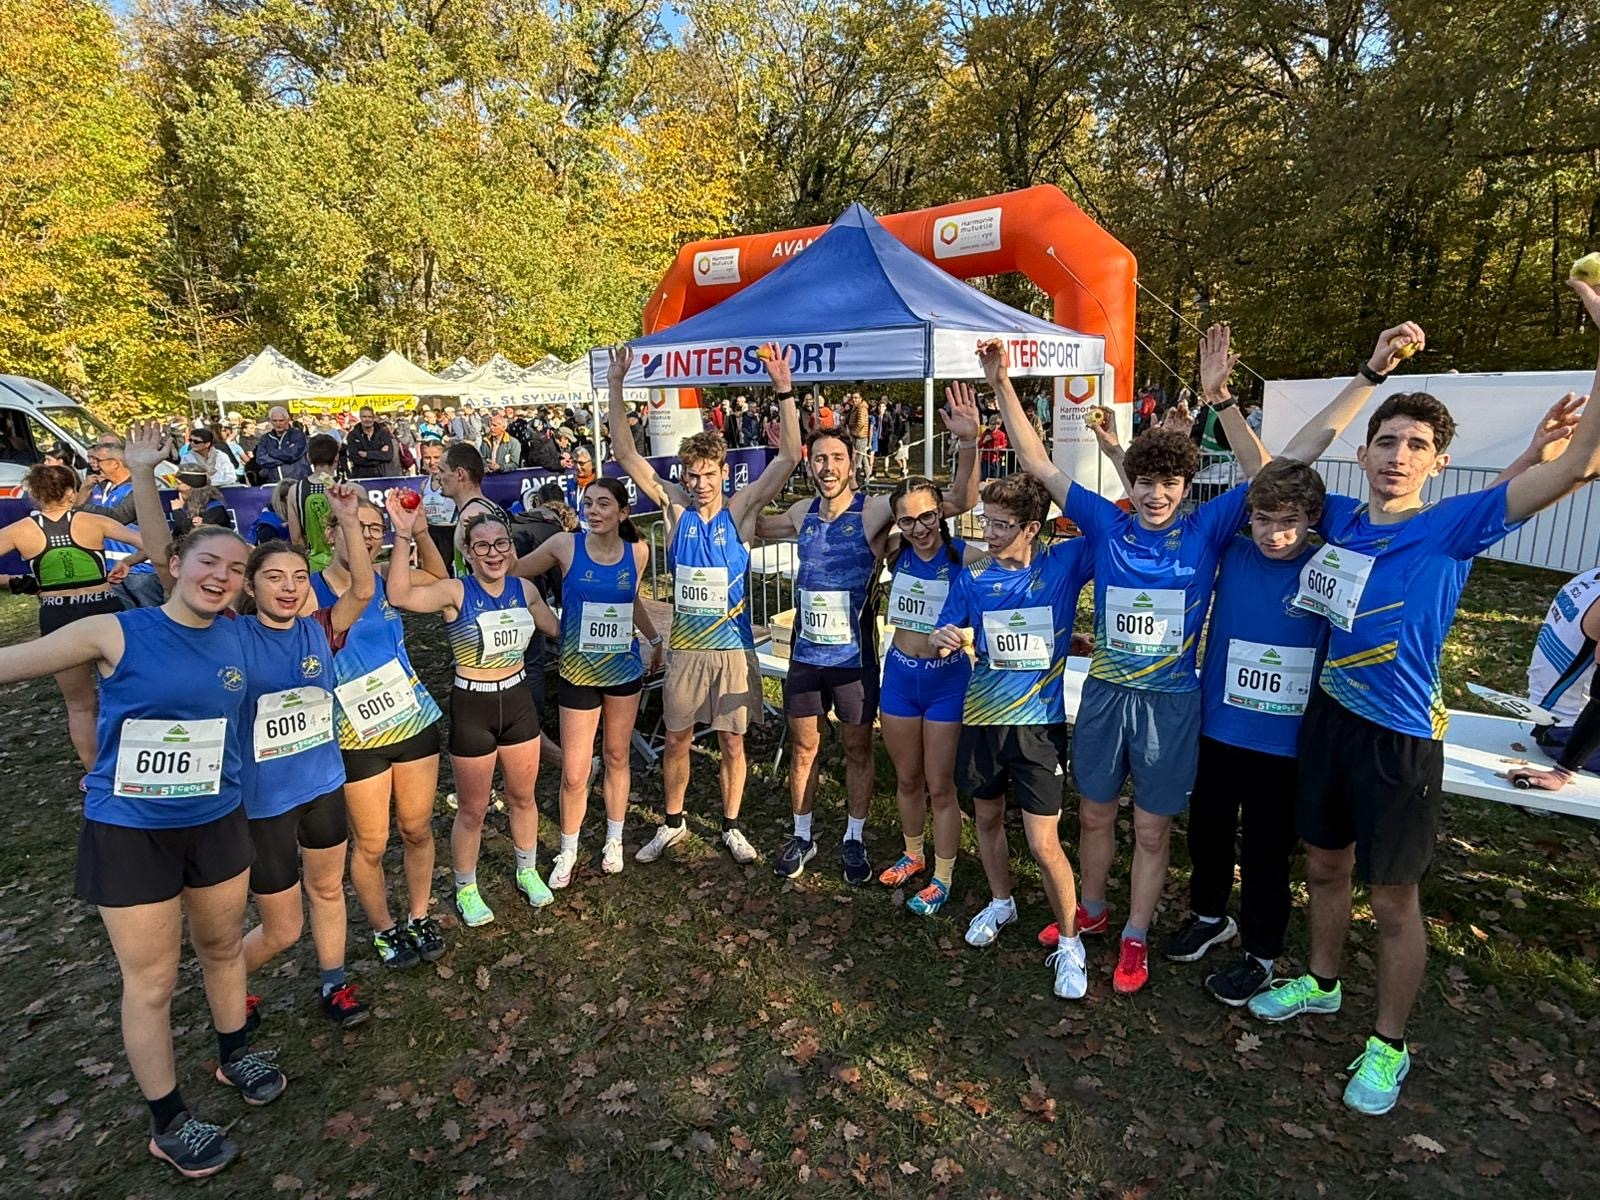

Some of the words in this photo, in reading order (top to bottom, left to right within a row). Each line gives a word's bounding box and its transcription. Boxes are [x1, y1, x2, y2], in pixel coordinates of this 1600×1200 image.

[666, 342, 843, 378] INTERSORT
[682, 585, 708, 601] 6016
[1308, 569, 1337, 599] 6018
[42, 596, 64, 606] PRO
[70, 592, 102, 605] NIKE
[898, 596, 926, 616] 6017
[804, 611, 828, 628] 6017
[1116, 613, 1154, 635] 6018
[494, 629, 518, 647] 6017
[590, 622, 618, 638] 6018
[996, 633, 1028, 652] 6017
[892, 650, 919, 668] PRO
[924, 652, 960, 669] NIKE
[469, 681, 498, 692] PUMA
[498, 673, 522, 691] PUMA
[1237, 667, 1282, 693] 6016
[358, 691, 395, 720] 6016
[266, 712, 307, 739] 6018
[136, 750, 191, 774] 6016
[195, 757, 202, 773] 1
